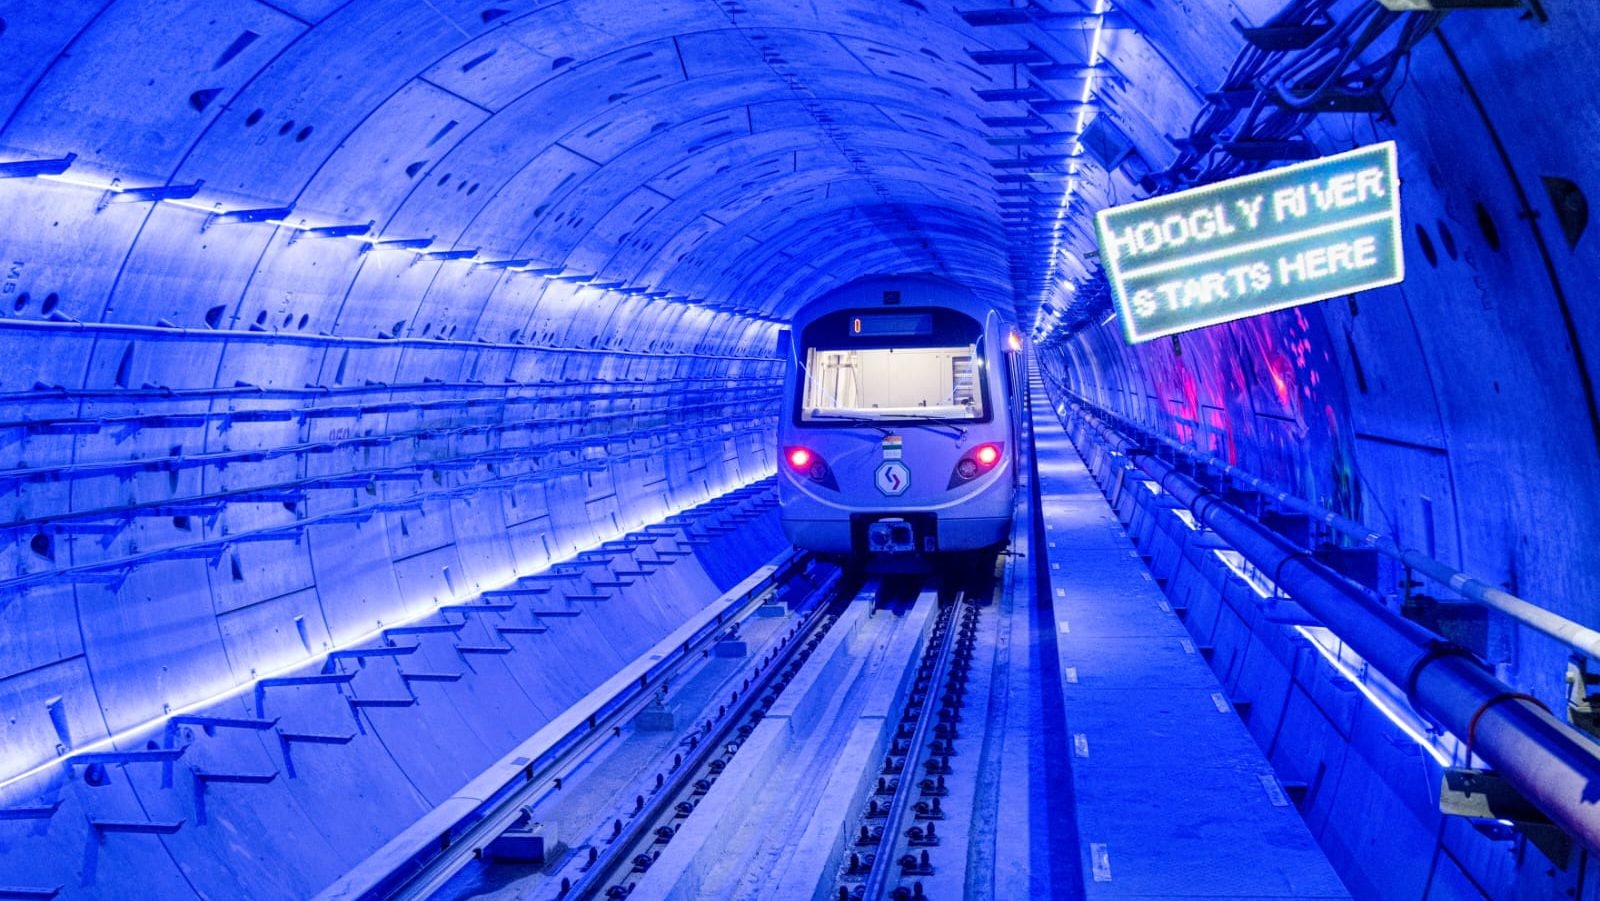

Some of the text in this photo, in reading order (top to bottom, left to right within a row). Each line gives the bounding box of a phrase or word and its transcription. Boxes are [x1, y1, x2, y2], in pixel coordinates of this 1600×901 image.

[1107, 166, 1385, 261] HOOGLY RIVER
[1133, 236, 1377, 318] STARTS HERE
